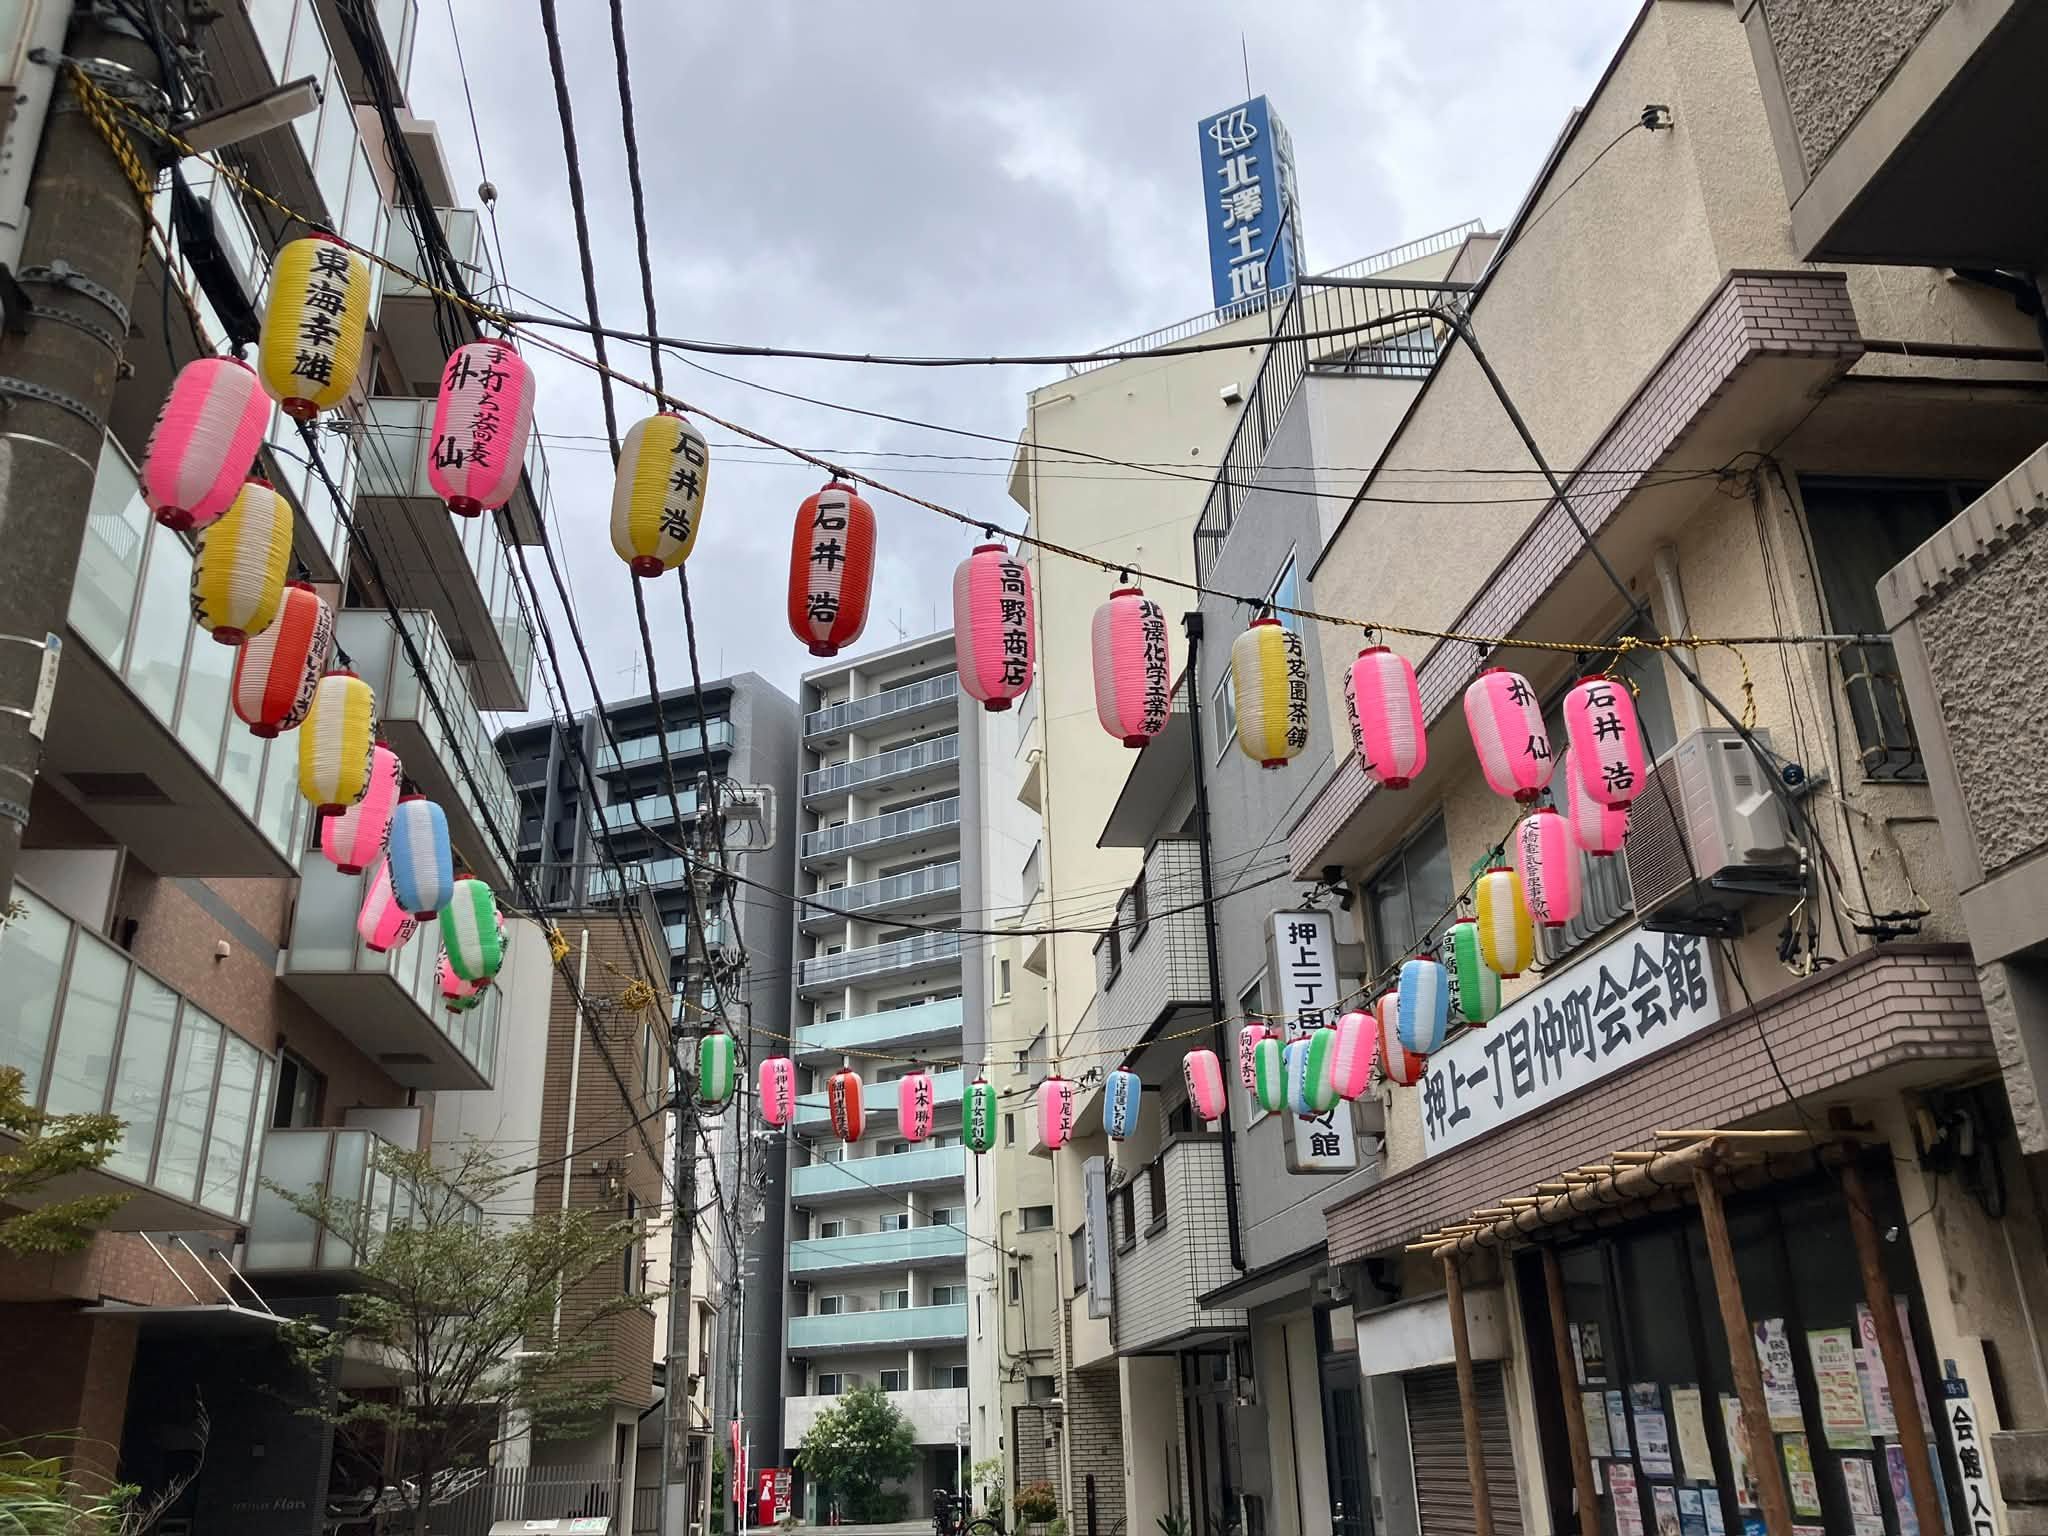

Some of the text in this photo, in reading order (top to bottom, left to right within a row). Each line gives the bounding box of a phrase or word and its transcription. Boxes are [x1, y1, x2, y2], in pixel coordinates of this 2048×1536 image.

[1217, 154, 1266, 303] 北澤土地
[290, 247, 350, 387] 東海幸雄
[660, 431, 704, 542] 石井浩
[806, 502, 847, 624] 石井浩
[997, 559, 1027, 687] 高野商店
[1584, 685, 1635, 791] 石井浩
[1424, 936, 1711, 1142] 押上一丁目仲町会会館
[914, 1080, 931, 1137] 山本勝信
[1057, 1086, 1073, 1143] 中尾正人
